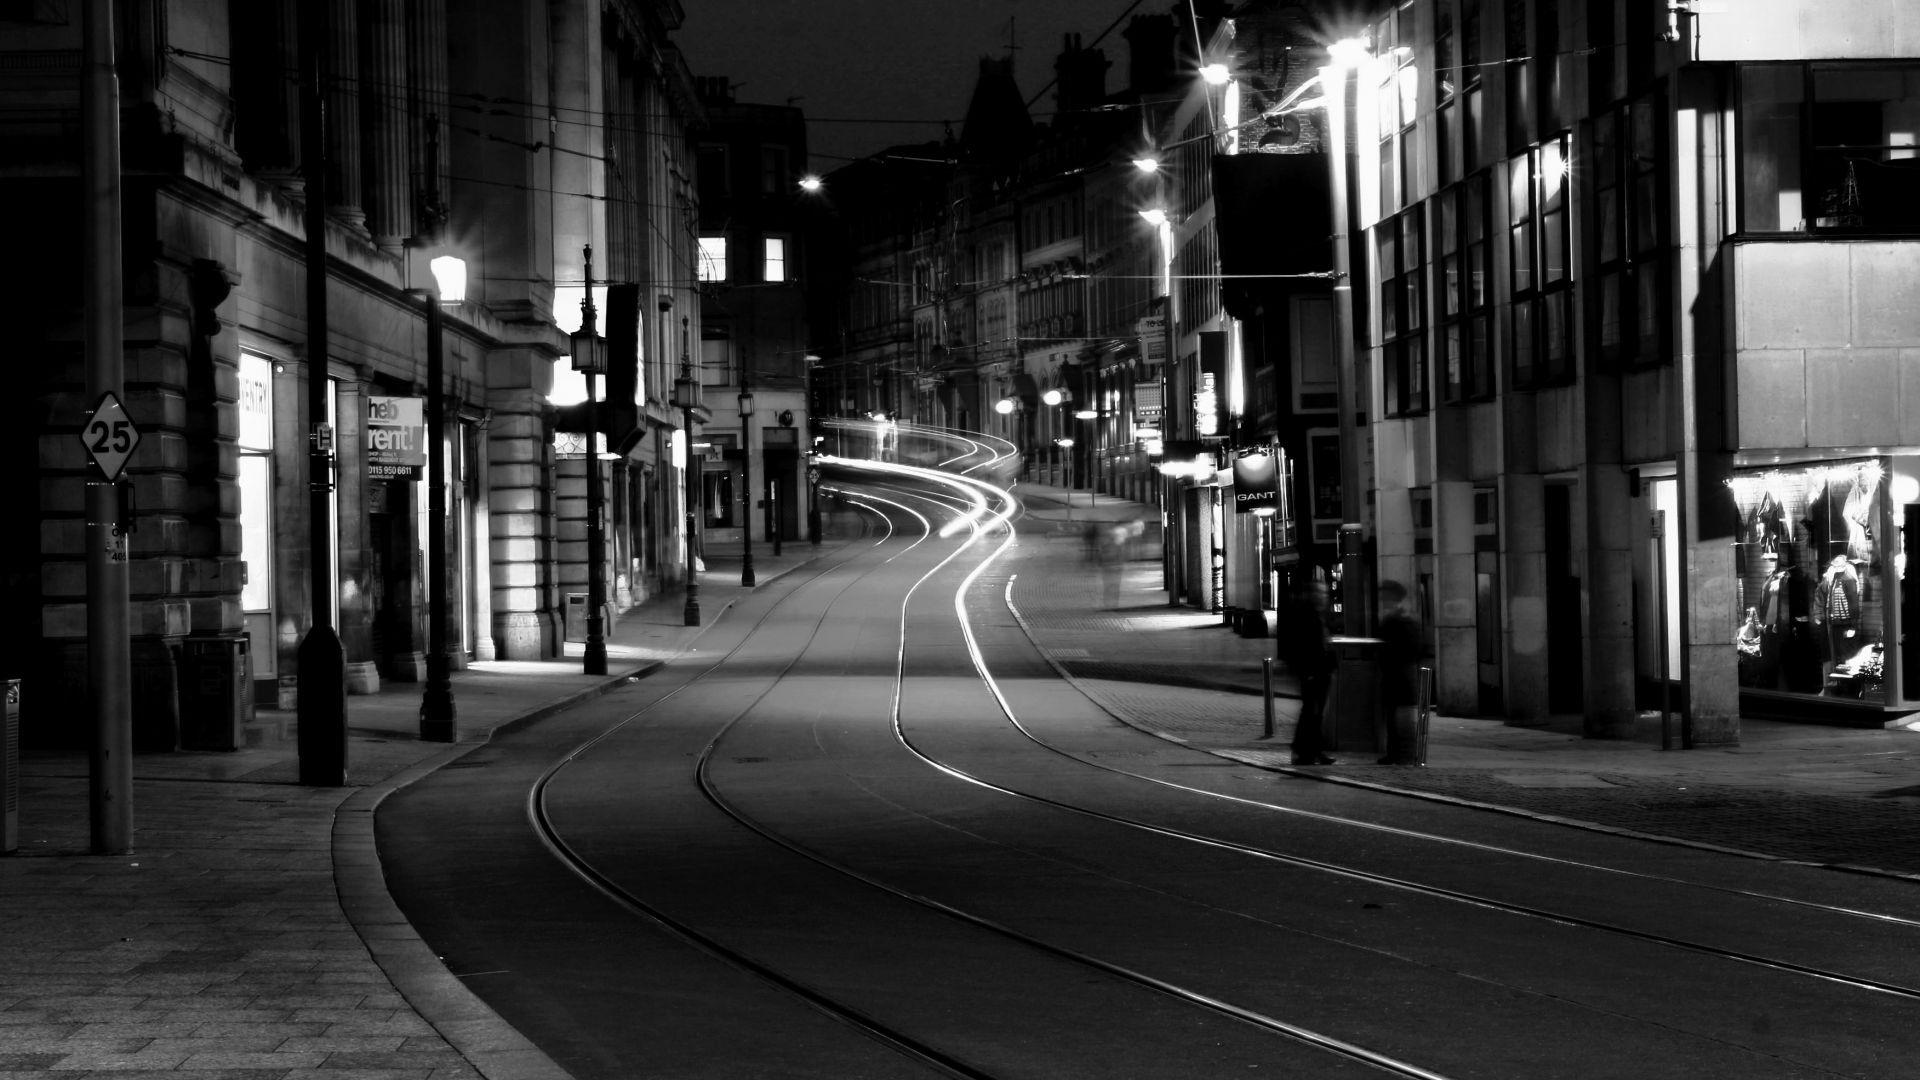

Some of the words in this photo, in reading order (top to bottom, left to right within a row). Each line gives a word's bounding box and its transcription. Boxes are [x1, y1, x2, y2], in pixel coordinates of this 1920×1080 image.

[368, 398, 398, 420] heb
[91, 421, 130, 453] 25
[368, 426, 414, 450] rent!
[383, 465, 397, 475] 950
[397, 466, 412, 475] 6611
[1237, 491, 1276, 502] GANT
